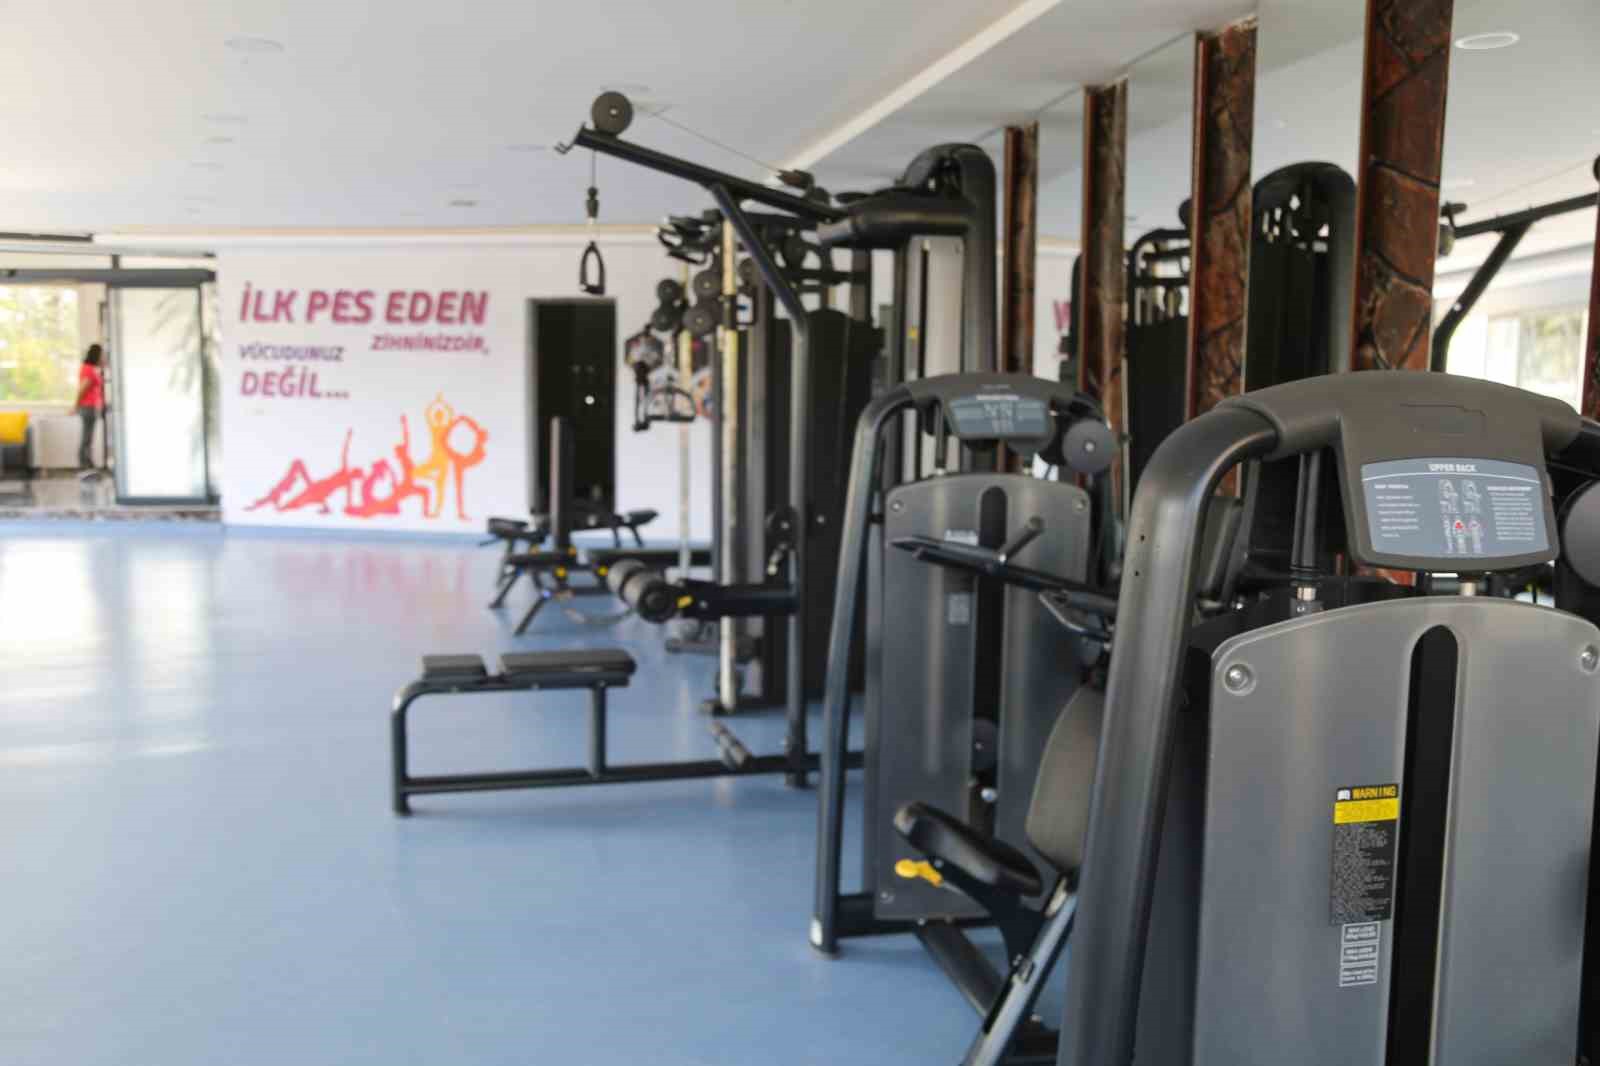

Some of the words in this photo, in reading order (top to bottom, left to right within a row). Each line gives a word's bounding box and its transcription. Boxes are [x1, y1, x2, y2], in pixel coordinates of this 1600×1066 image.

[240, 281, 297, 322] İLK
[306, 289, 375, 324] PES
[384, 291, 489, 324] EDEN
[1428, 463, 1455, 472] UPPER
[1353, 785, 1397, 800] WARNING
